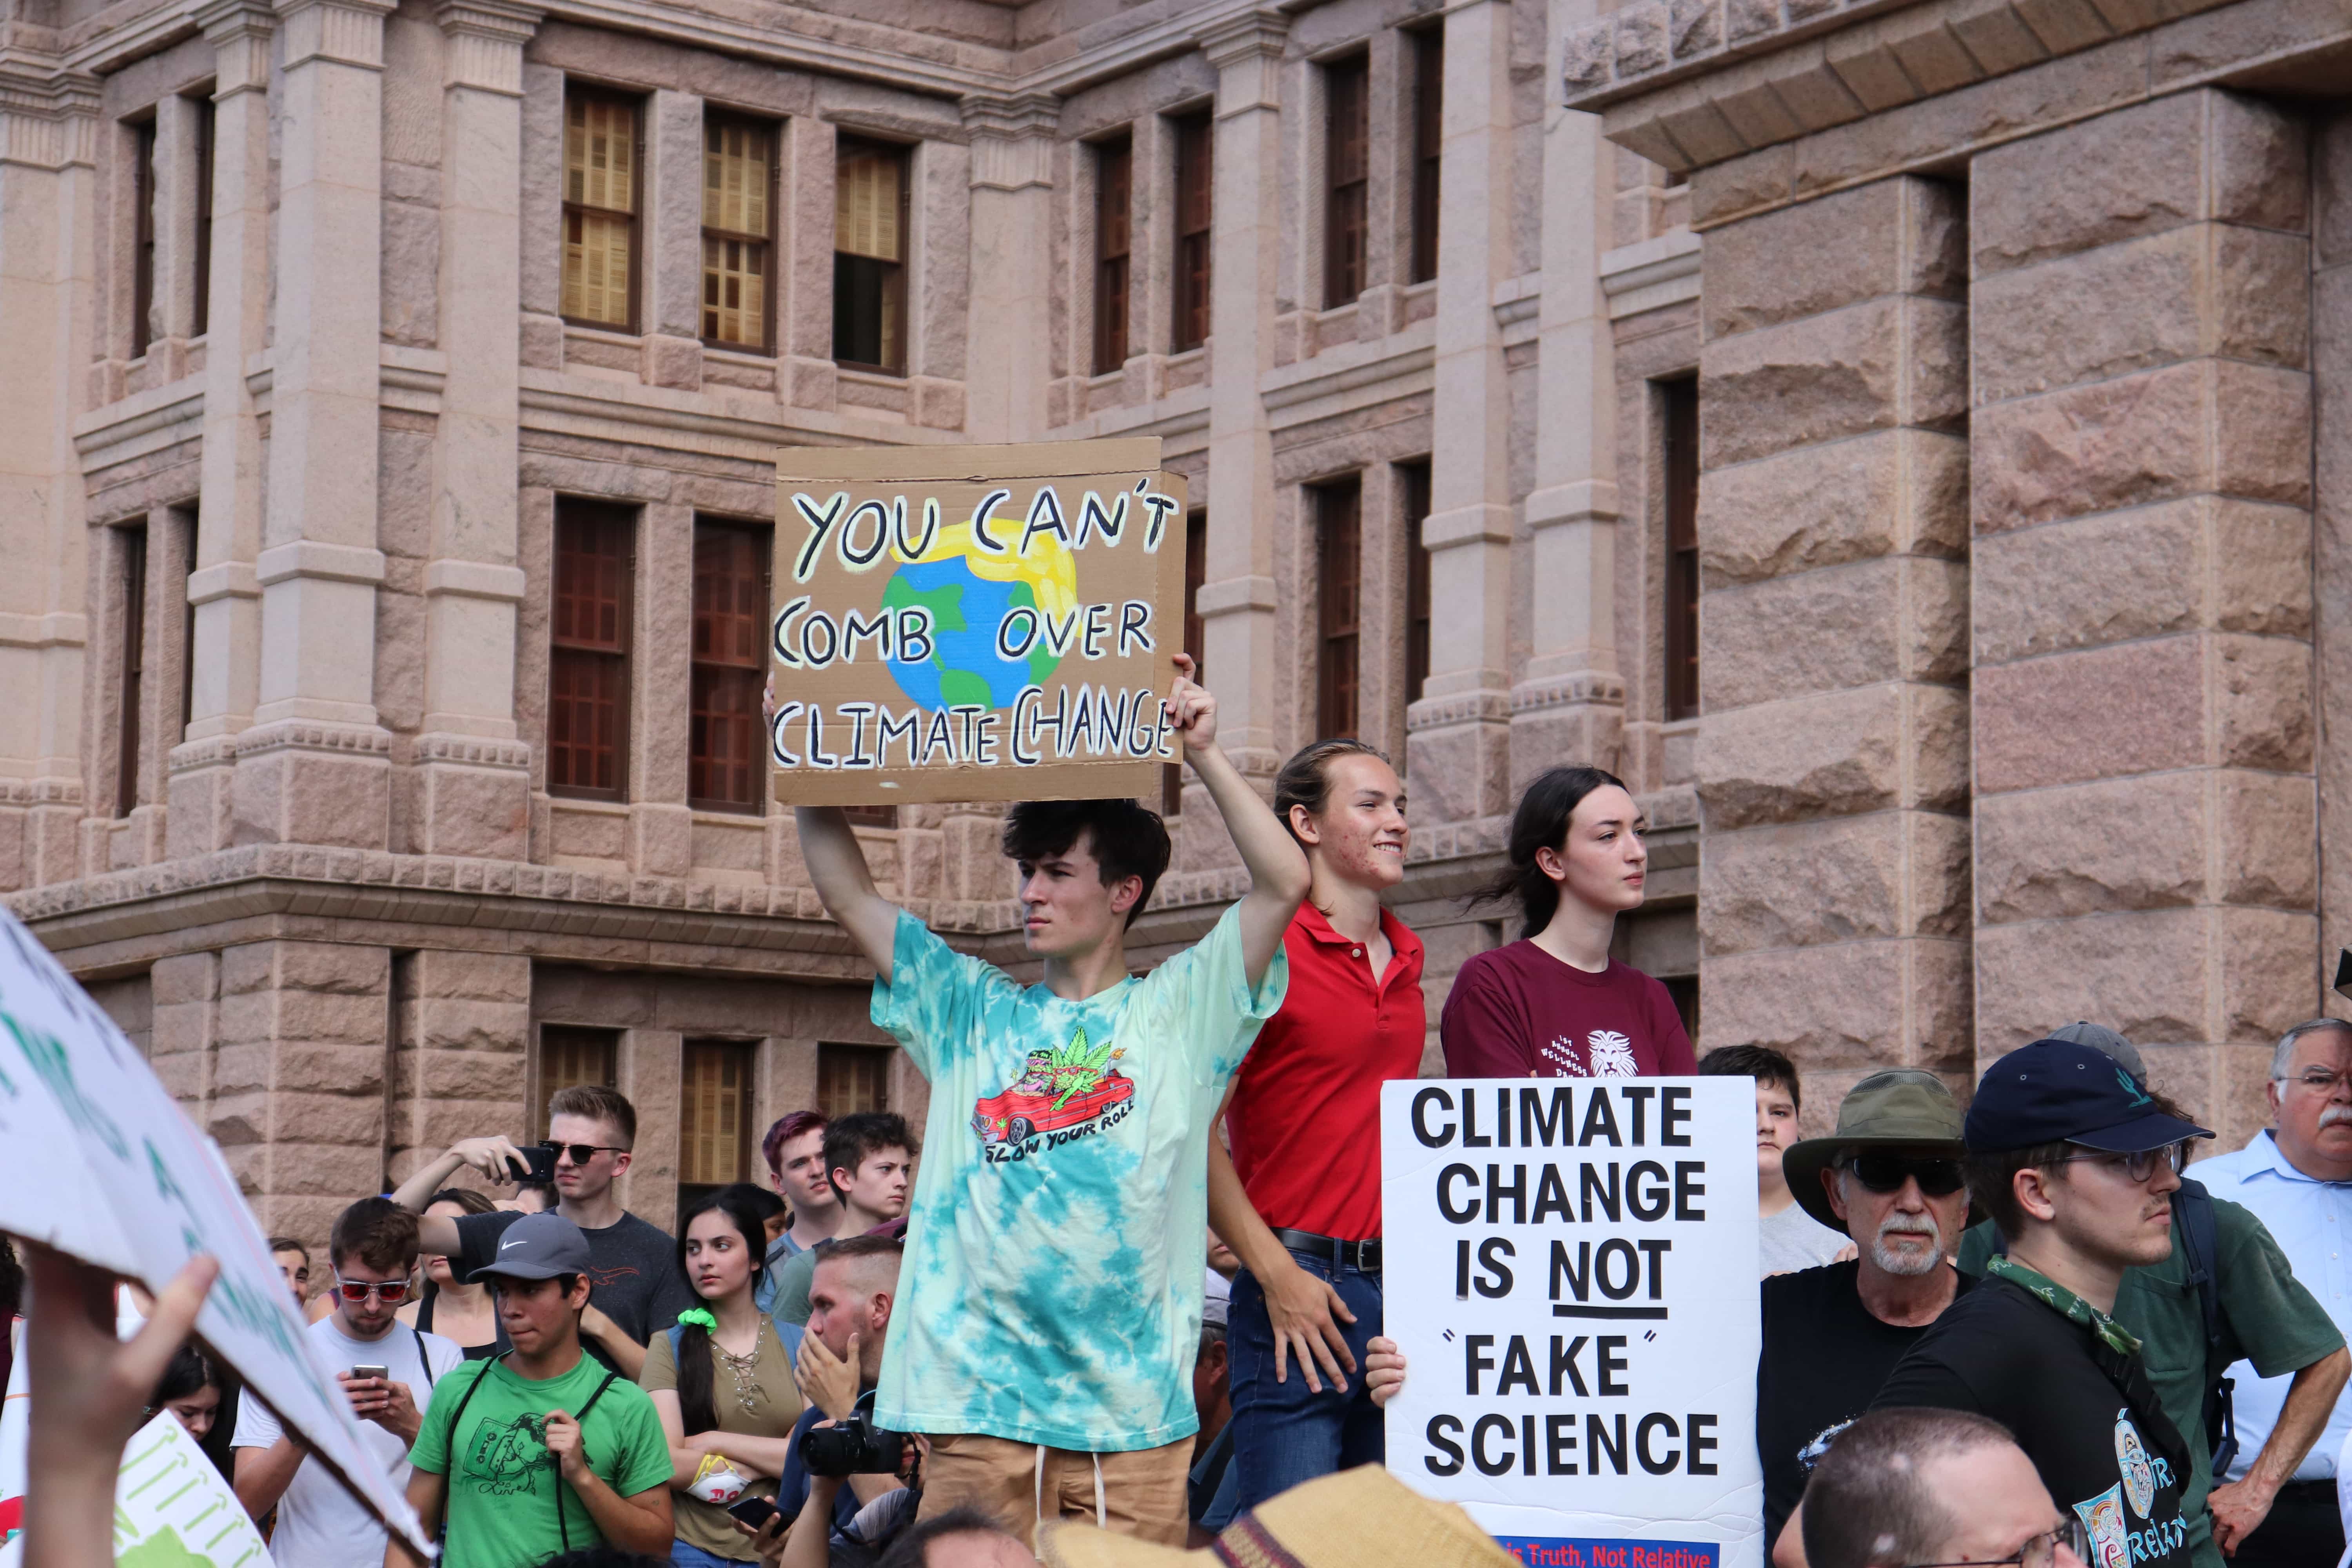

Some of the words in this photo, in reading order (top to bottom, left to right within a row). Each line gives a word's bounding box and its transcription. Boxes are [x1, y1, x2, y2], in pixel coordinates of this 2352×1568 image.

[791, 490, 939, 583] YOU
[970, 477, 1179, 555] CAN'T
[775, 596, 934, 668] COMB
[996, 600, 1155, 661] OVER
[774, 701, 999, 769] CLIMATE
[1010, 683, 1176, 766] CHANGE
[1541, 1048, 1587, 1076] WELLNESS
[1552, 1040, 1579, 1060] ANNUAL
[985, 1139, 1040, 1163] SLOW
[1047, 1123, 1095, 1151] YOUR
[1101, 1100, 1134, 1131] ROLL
[1411, 1087, 1691, 1148] CLIMATE
[1437, 1160, 1705, 1224] CHANGE
[1456, 1237, 1515, 1301] IS
[1549, 1238, 1671, 1301] NOT
[1424, 1412, 1718, 1476] SCIENCE
[1527, 1544, 1586, 1568] Truth,
[1593, 1546, 1627, 1568] Not
[1633, 1547, 1710, 1568] Relative
